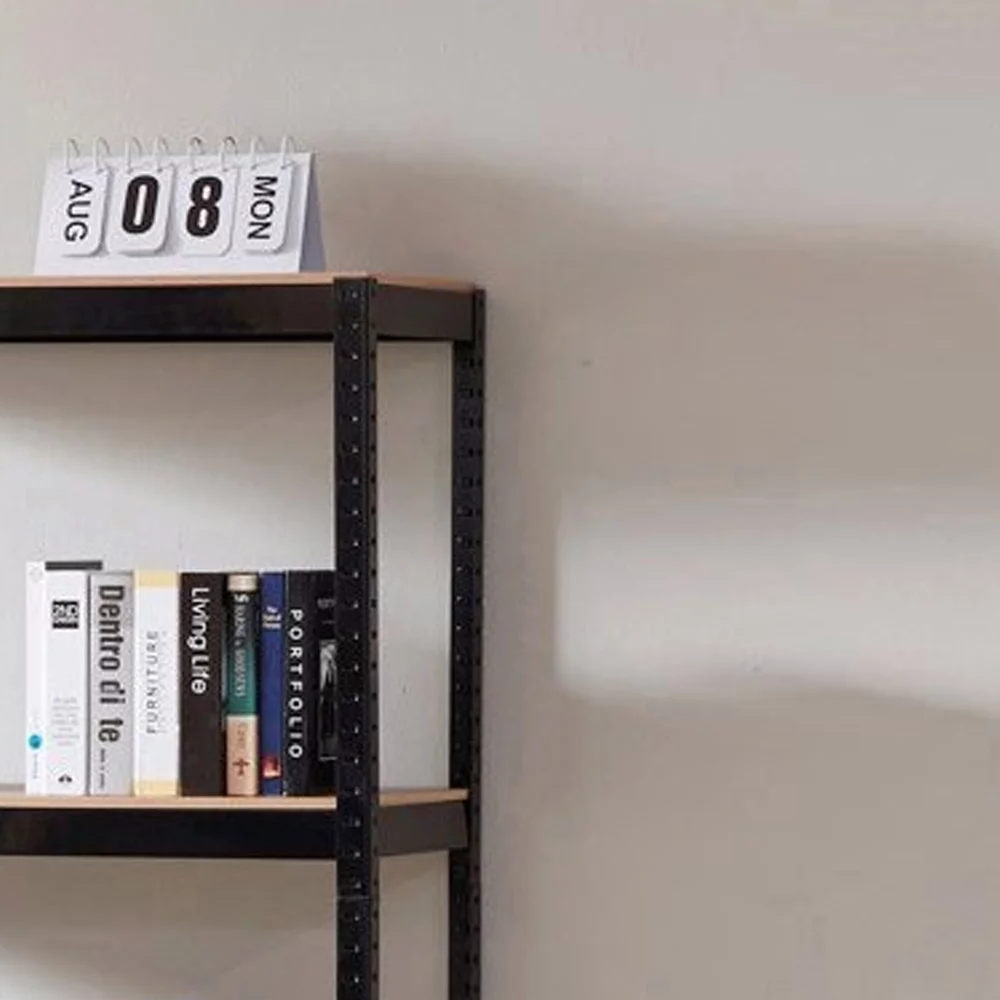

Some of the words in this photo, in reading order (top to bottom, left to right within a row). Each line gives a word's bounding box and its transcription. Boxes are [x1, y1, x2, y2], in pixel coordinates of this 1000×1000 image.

[64, 180, 92, 242] AUG
[248, 176, 278, 239] MON
[98, 585, 126, 671] Dentro
[99, 680, 126, 704] di
[146, 631, 159, 734] FURNITURE
[191, 653, 210, 694] Life
[288, 608, 303, 759] PORTFOLIO
[98, 718, 123, 743] te
